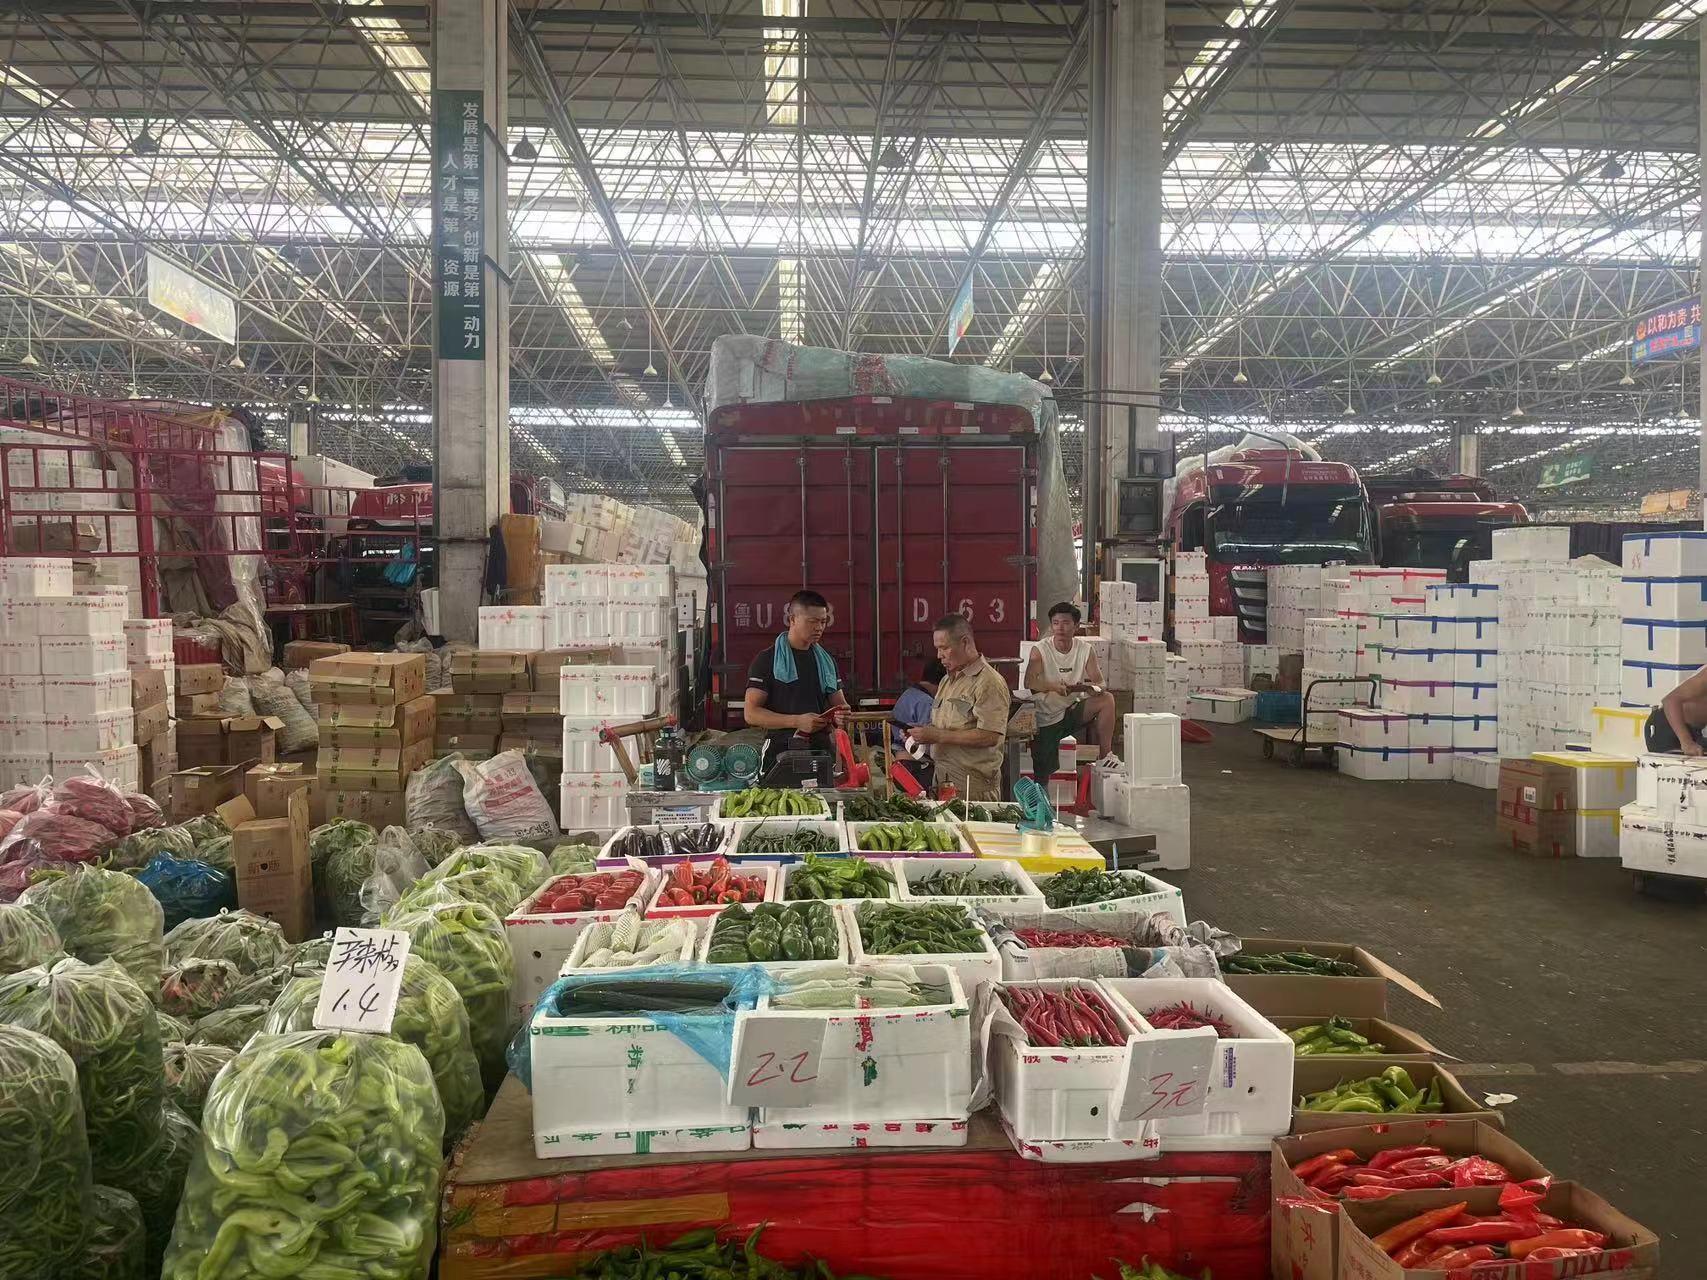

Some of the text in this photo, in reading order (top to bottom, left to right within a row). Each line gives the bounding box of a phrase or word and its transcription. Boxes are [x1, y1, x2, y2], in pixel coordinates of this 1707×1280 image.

[442, 153, 460, 297] 人才是第一资源
[332, 983, 380, 1022] 1.4
[747, 1051, 818, 1087] 2.2
